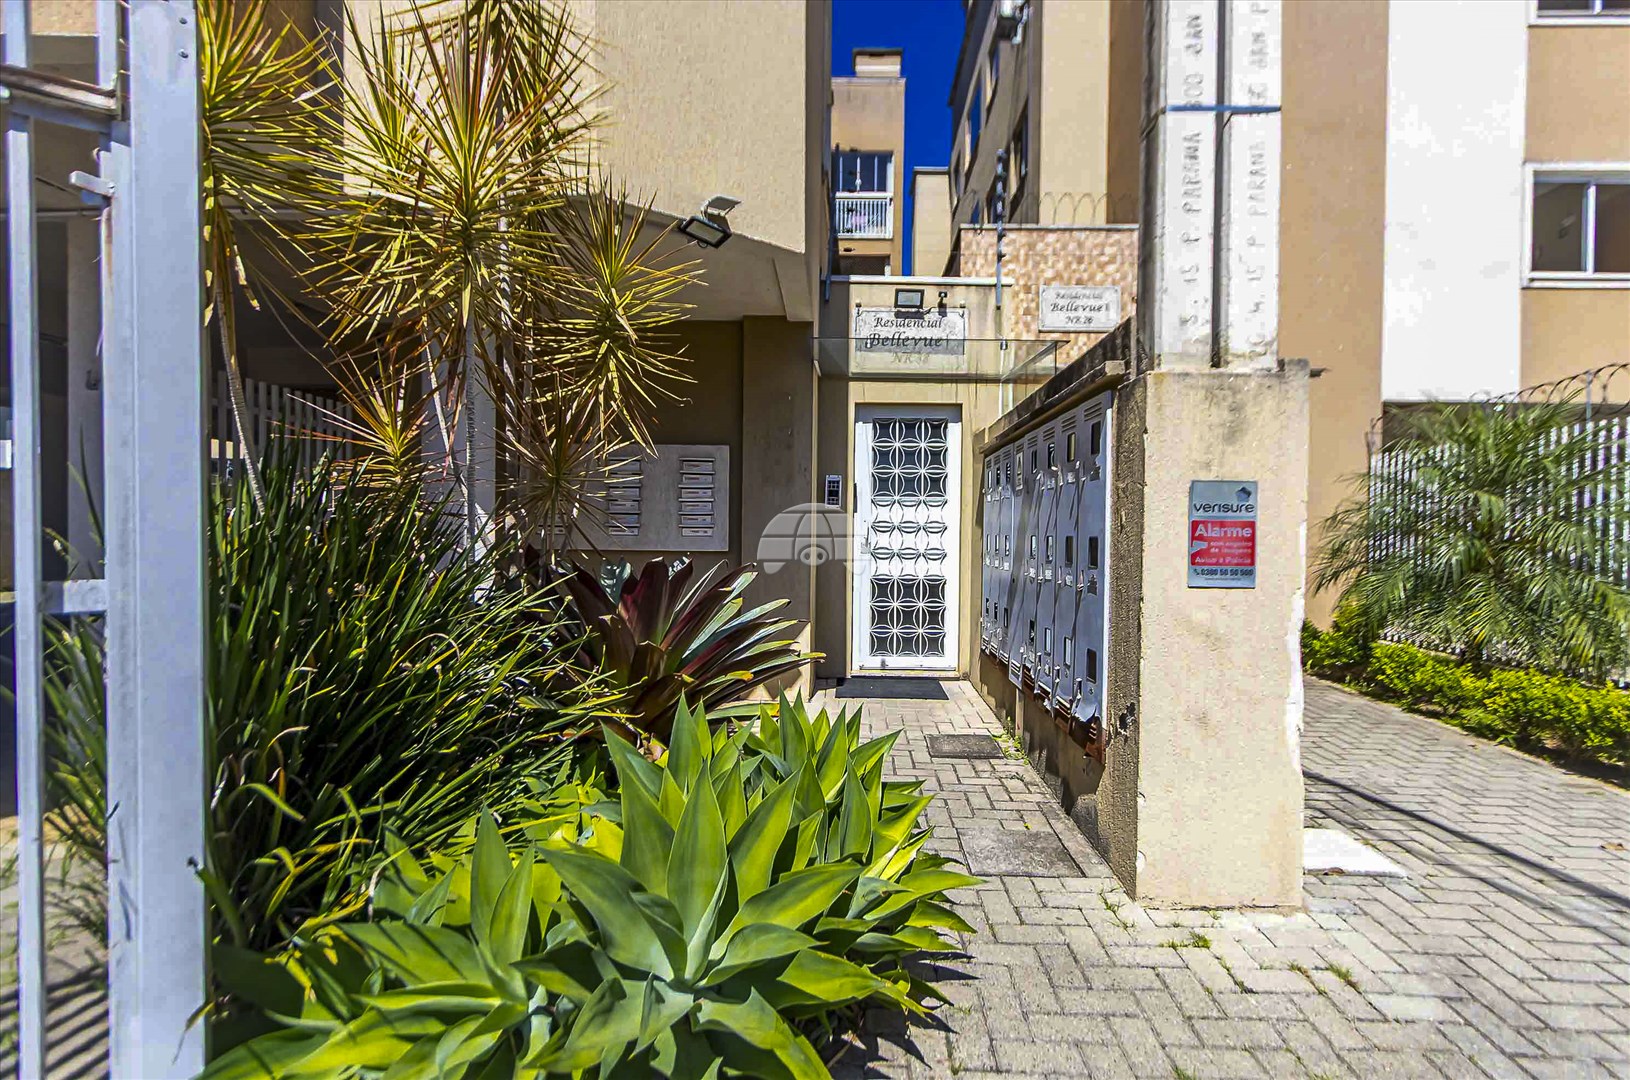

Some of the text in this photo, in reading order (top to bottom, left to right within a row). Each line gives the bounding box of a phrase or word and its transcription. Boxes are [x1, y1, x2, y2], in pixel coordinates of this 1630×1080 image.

[1182, 131, 1203, 215] PARANA
[1247, 141, 1269, 217] PARANA
[1050, 301, 1104, 312] Bellevue
[873, 314, 943, 329] Residencial
[868, 331, 943, 349] Bellevue
[1193, 503, 1255, 513] verisure
[1194, 523, 1253, 537] Alarme
